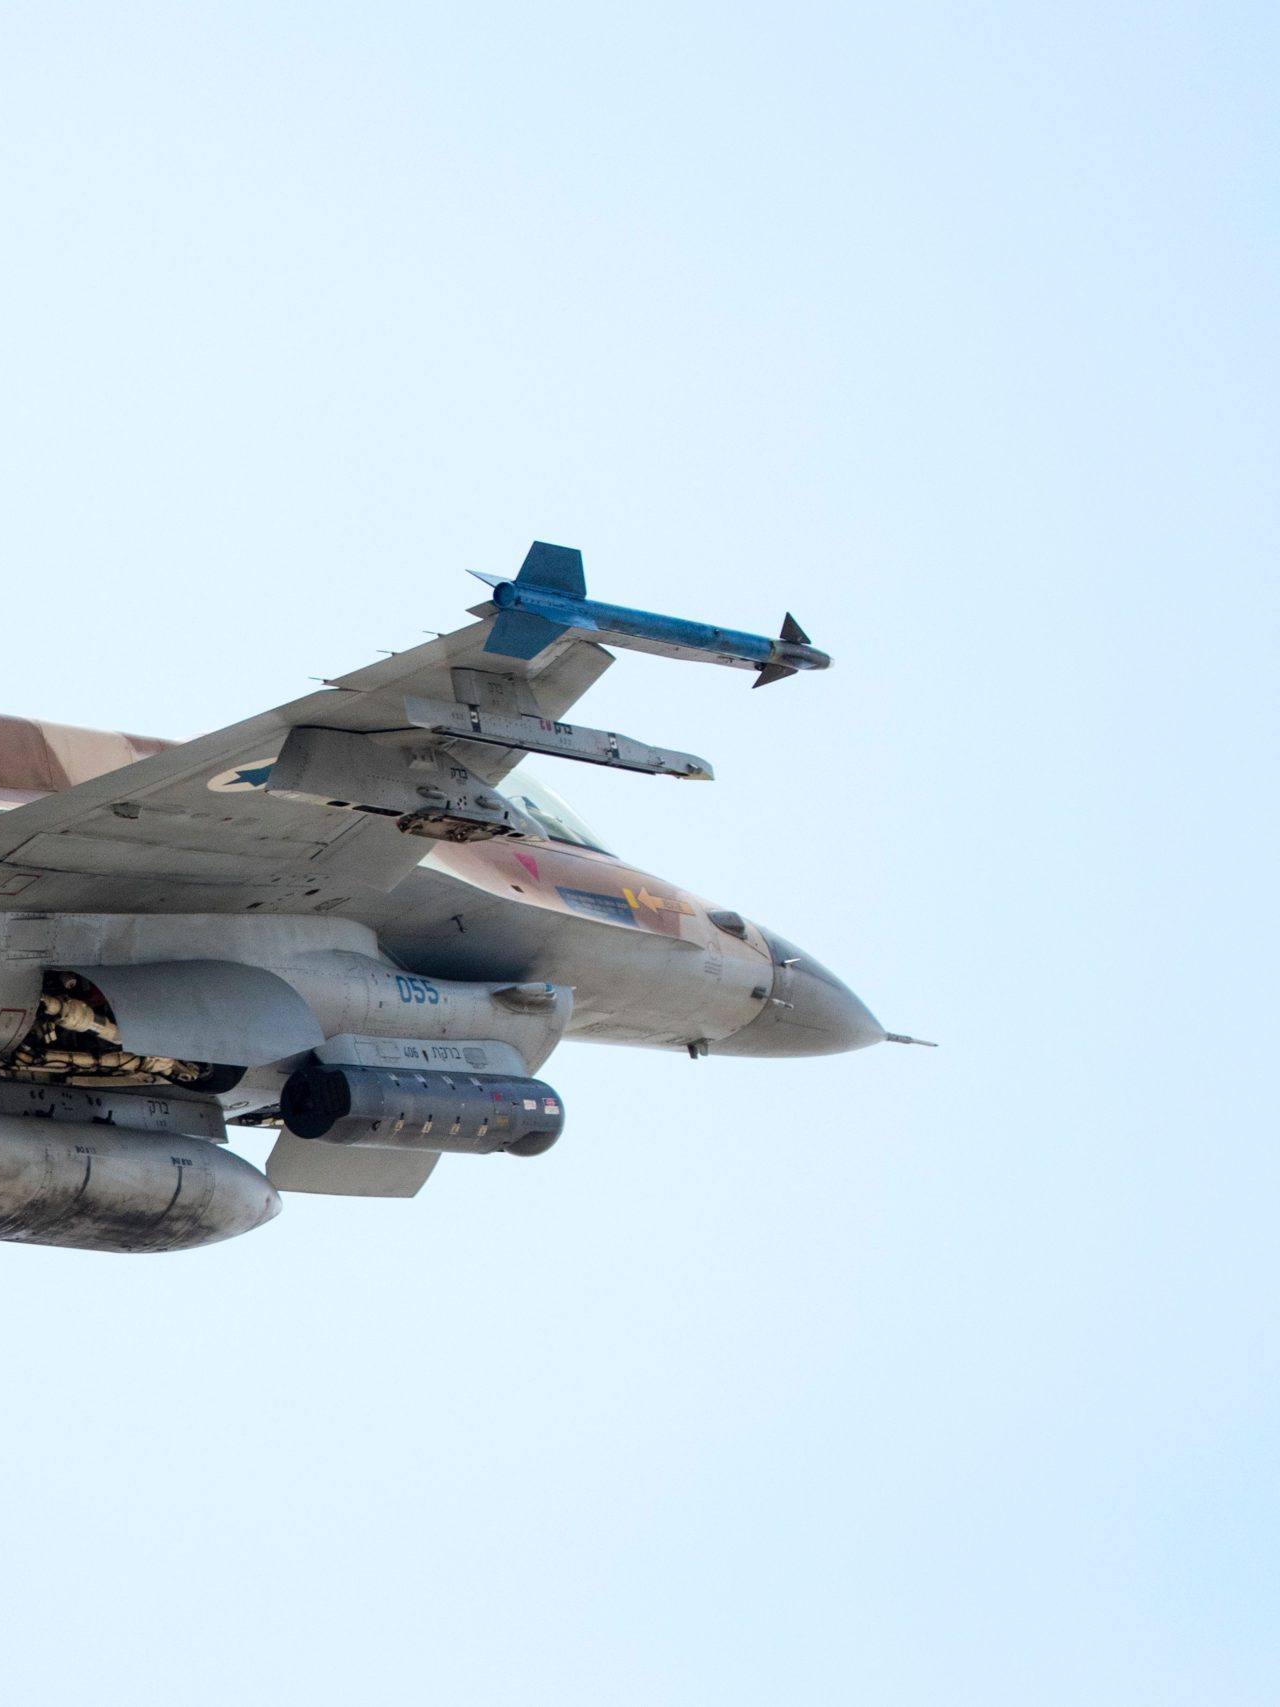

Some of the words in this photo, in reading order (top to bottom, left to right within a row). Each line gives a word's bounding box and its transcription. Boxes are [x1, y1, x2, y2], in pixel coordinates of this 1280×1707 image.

[450, 767, 468, 779] ברק
[395, 975, 439, 1004] 055
[148, 1101, 170, 1116] ברק
